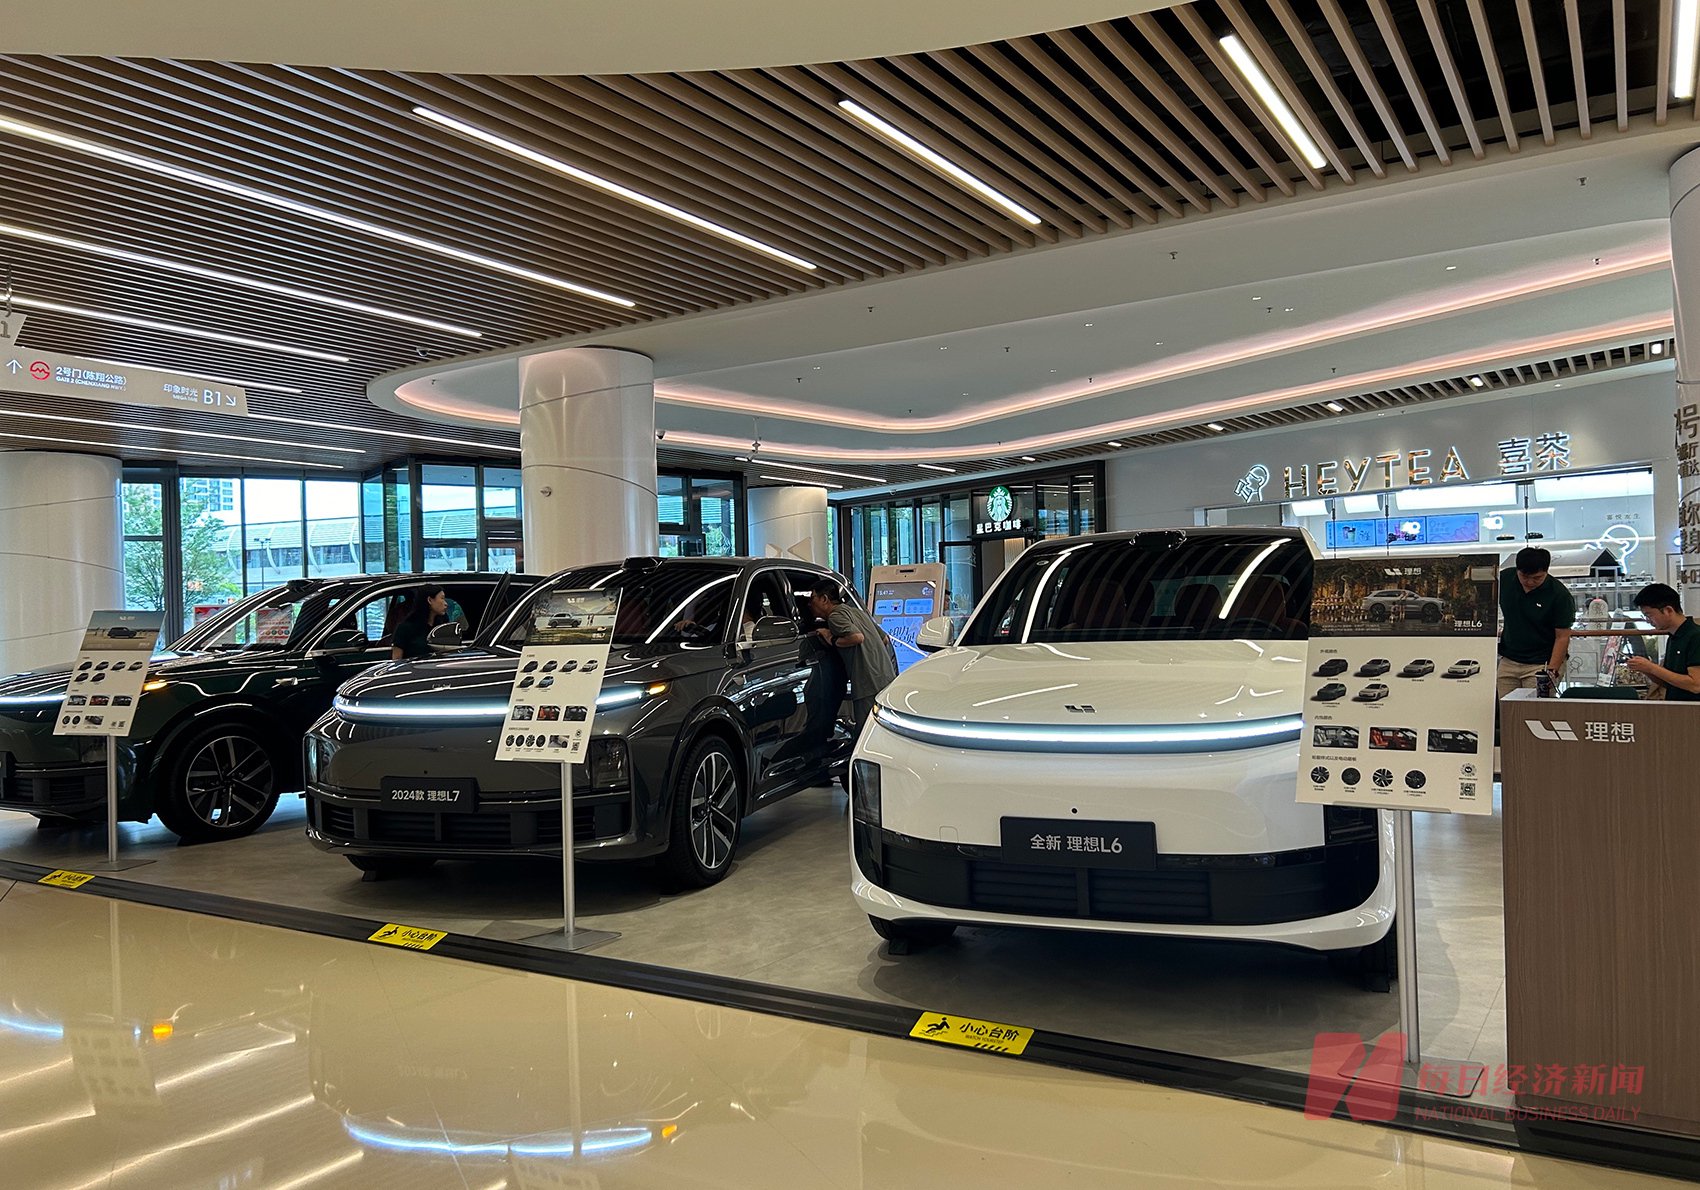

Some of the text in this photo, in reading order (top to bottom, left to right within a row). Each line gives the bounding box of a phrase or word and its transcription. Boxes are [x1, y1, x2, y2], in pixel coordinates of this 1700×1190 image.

[56, 366, 127, 386] 2号门(陈翔公路)
[203, 389, 221, 406] B1
[1497, 431, 1570, 476] 喜茶
[1284, 445, 1470, 498] HEYTEA
[976, 518, 1022, 535] 星巴克咖啡
[1404, 567, 1422, 576] 理想
[1454, 620, 1483, 628] 理想L6
[1585, 721, 1635, 743] 理想
[391, 789, 460, 802] 2024款 理想L7
[1030, 834, 1123, 854] 全新 理想L6
[960, 1022, 1020, 1042] 小心台阶
